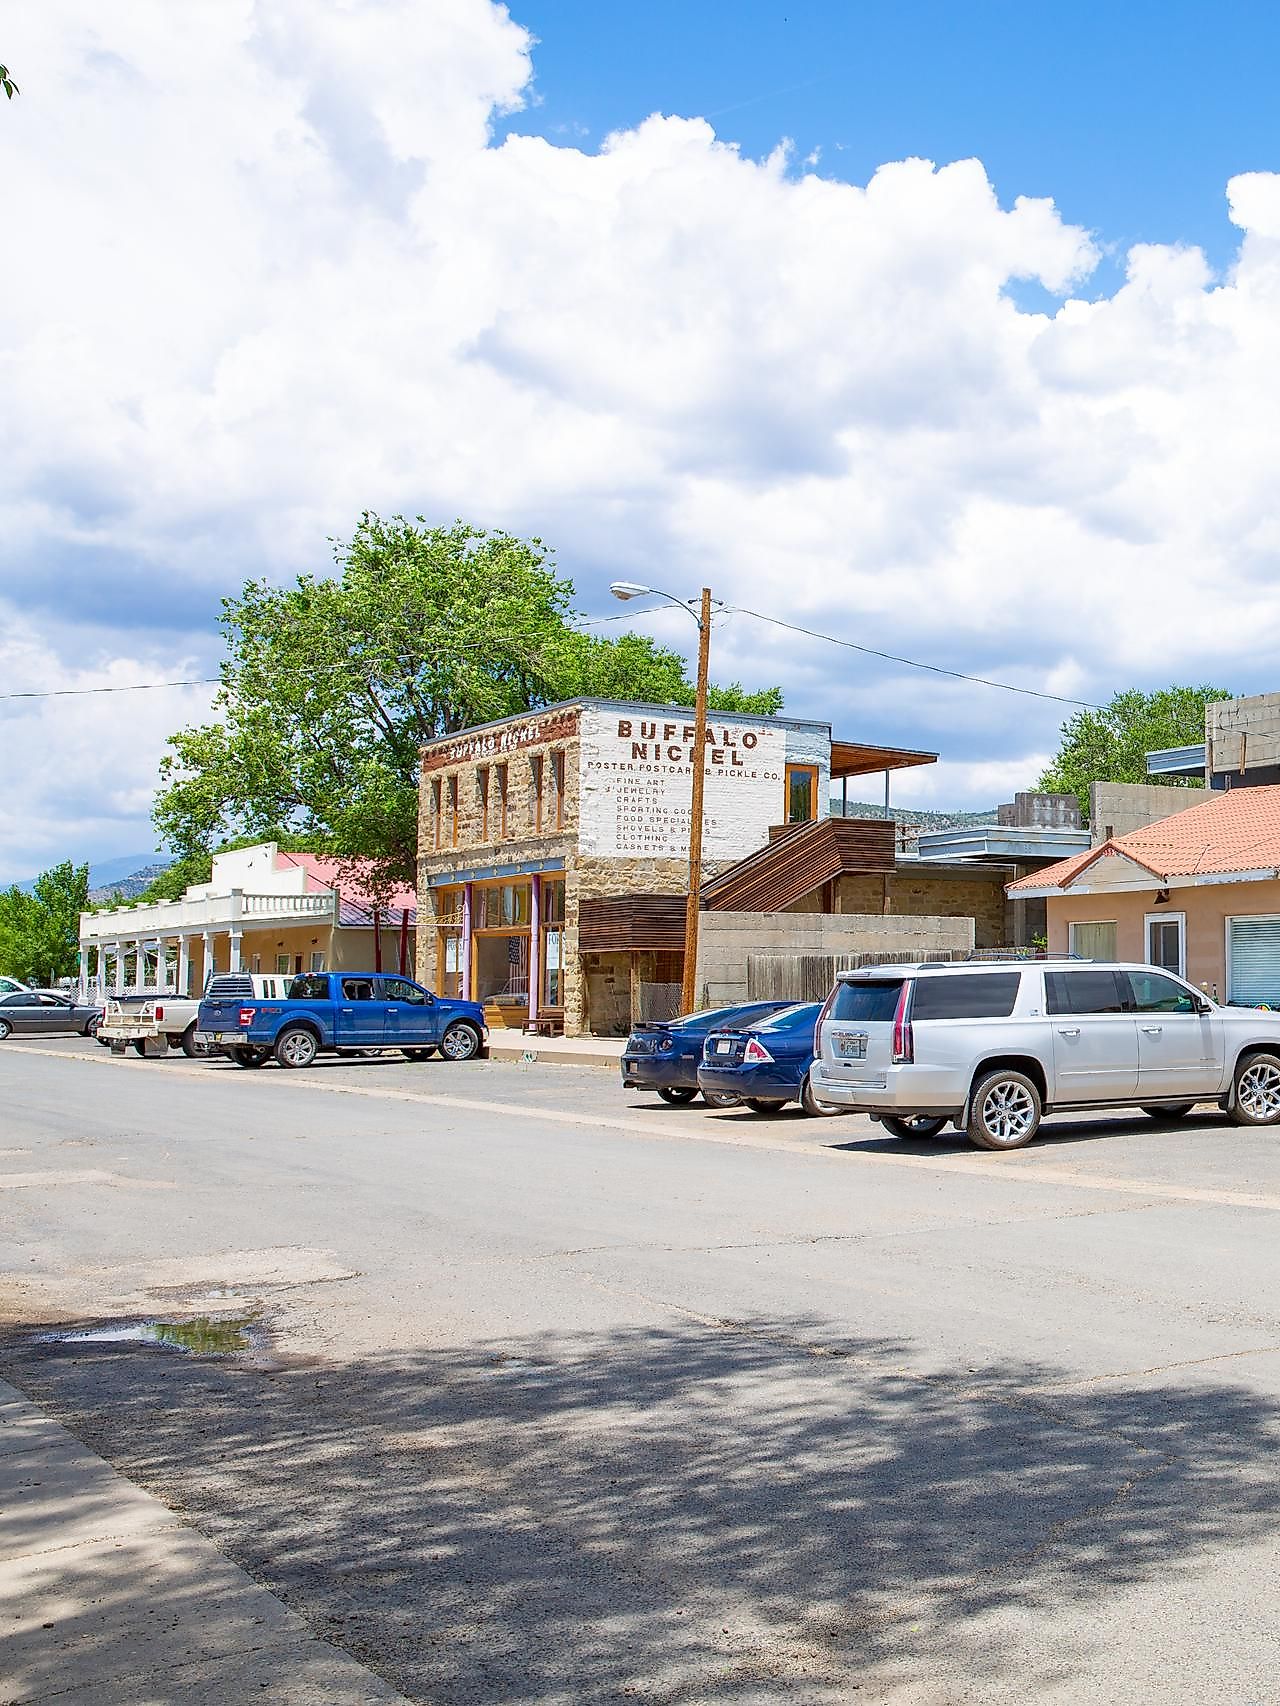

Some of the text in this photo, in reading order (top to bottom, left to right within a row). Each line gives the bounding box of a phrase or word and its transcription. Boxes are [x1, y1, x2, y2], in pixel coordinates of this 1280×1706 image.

[618, 720, 758, 749] BUFFALO
[639, 763, 692, 775] POSTCAR
[717, 769, 758, 779] PICKLE
[764, 771, 781, 782] CO.
[616, 777, 641, 785] FINE
[616, 786, 665, 796] JEWELRY
[616, 796, 658, 805] CRAFTS
[616, 805, 668, 815] SPORTING
[616, 815, 717, 826] FOOD SPECIALES
[616, 824, 664, 833] SHOVELS
[681, 826, 710, 835] PIS
[616, 833, 668, 842] CLOTHING
